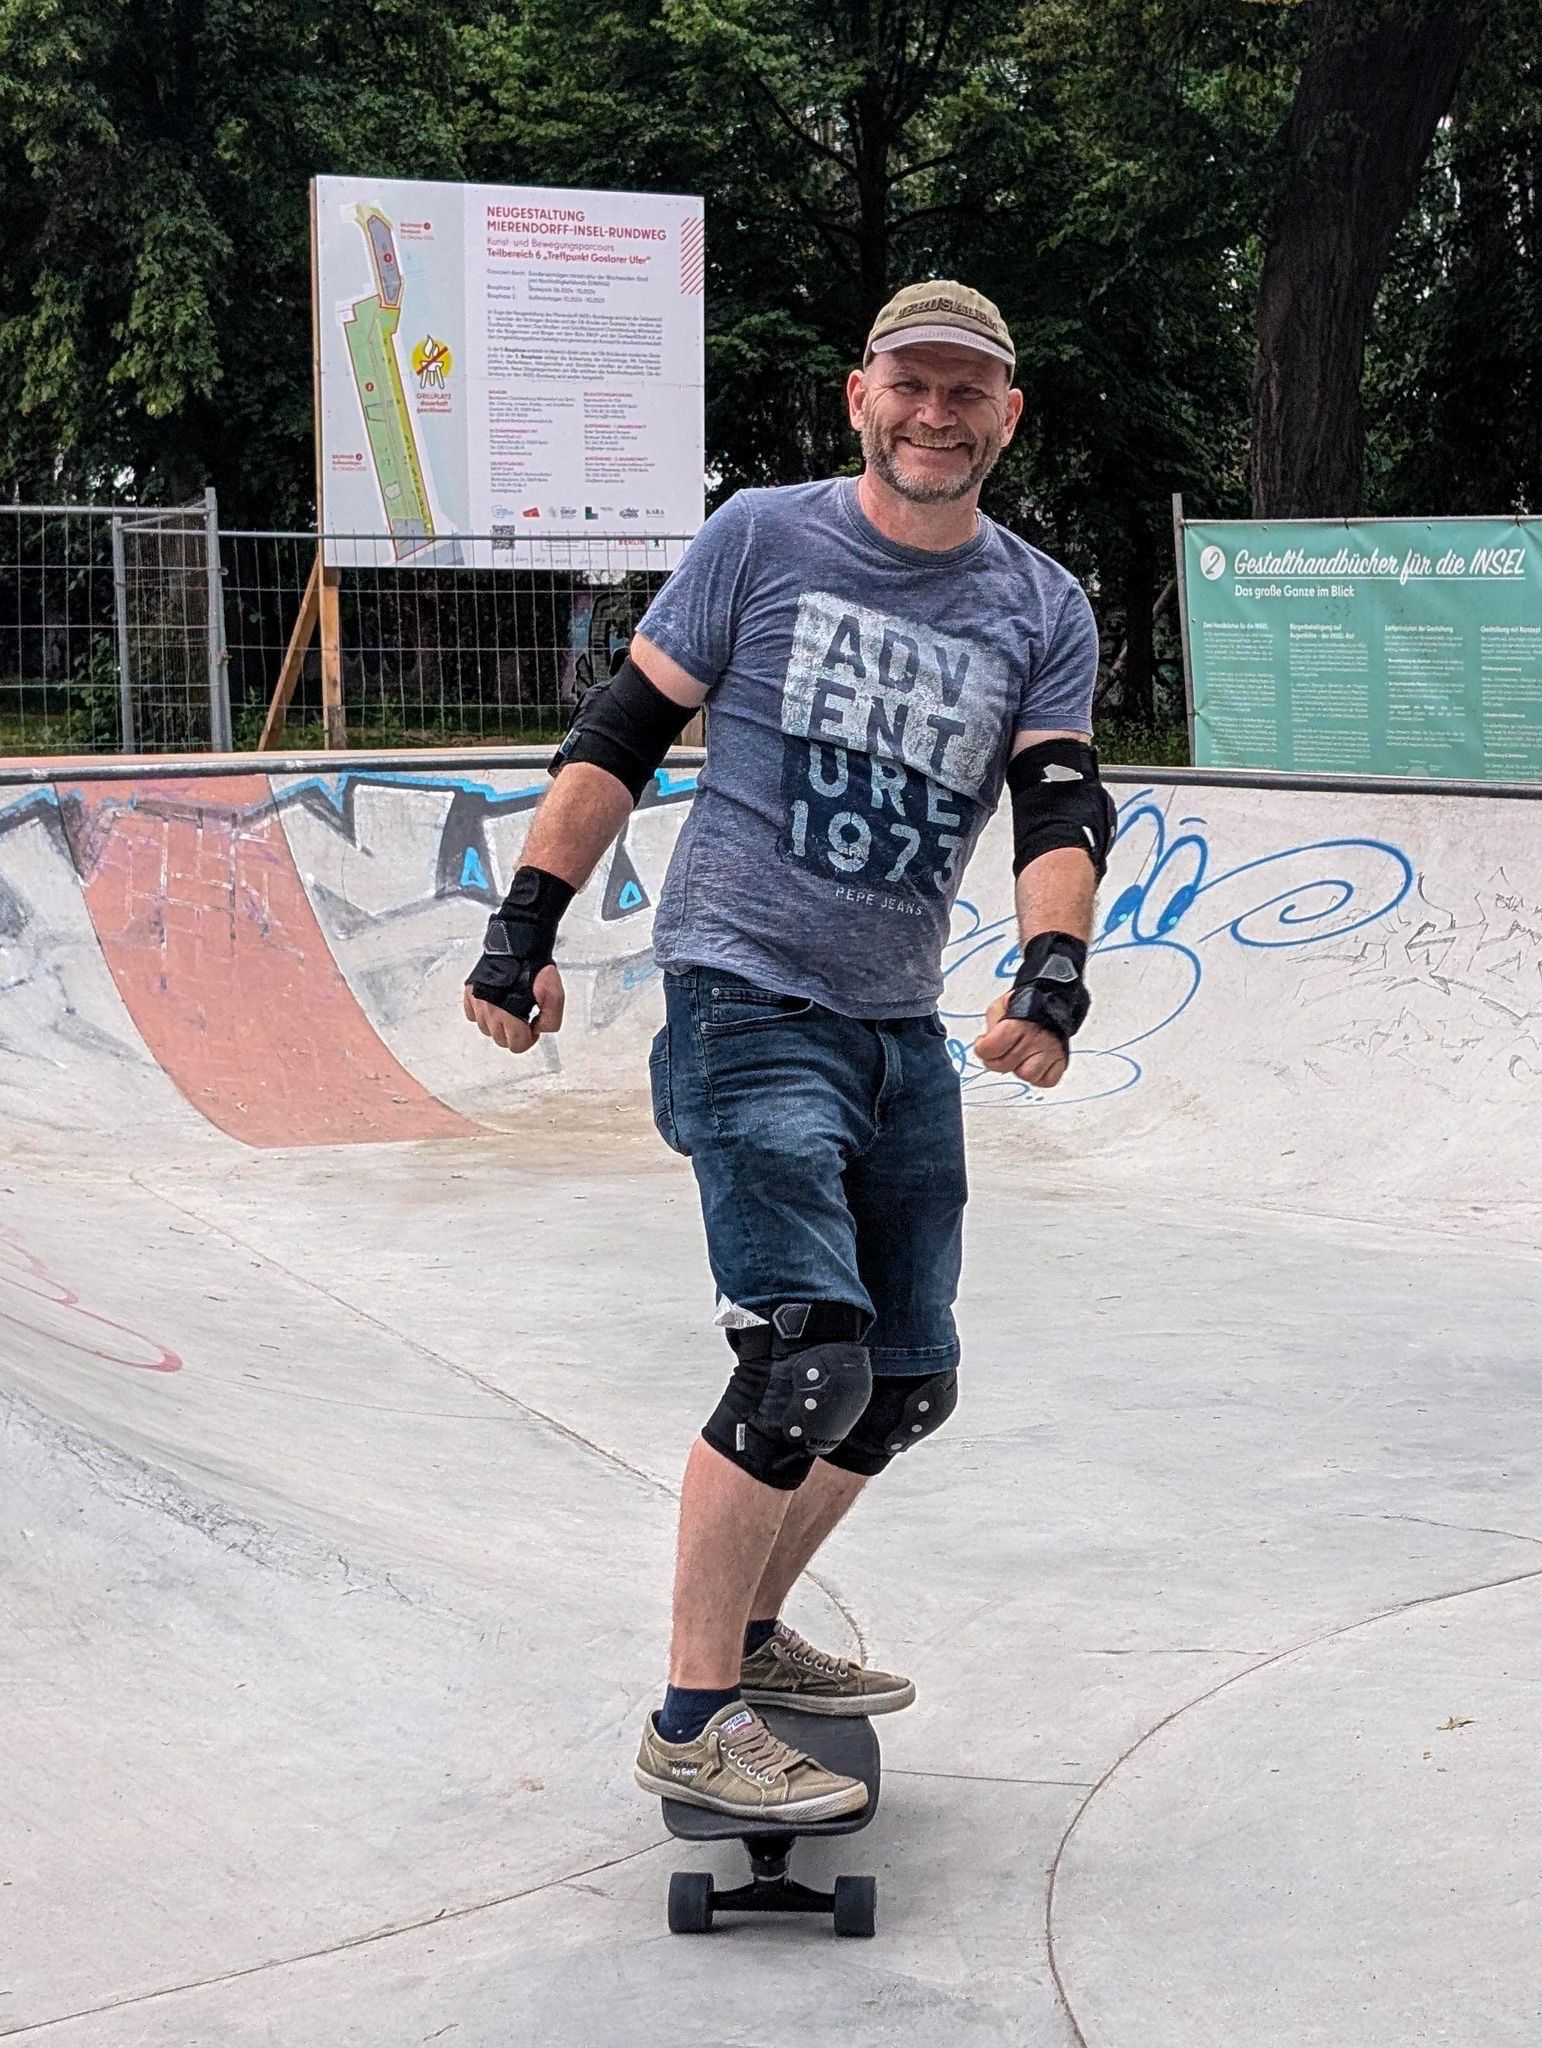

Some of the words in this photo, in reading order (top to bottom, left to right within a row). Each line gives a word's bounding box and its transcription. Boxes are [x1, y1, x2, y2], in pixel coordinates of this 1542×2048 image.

[487, 206, 585, 222] NEUGESTALTUNG
[487, 220, 667, 240] MIERENDORFF-INSEL-RUNDWEG
[487, 248, 534, 259] Teilbereich
[535, 251, 541, 259] 6
[590, 253, 627, 264] Goslarer
[513, 239, 529, 247] und
[531, 238, 615, 252] Bewegungsparcours
[1205, 551, 1220, 575] 2
[1234, 548, 1399, 575] Gestalthandbücher
[1400, 549, 1432, 586] für
[1436, 548, 1465, 575] die
[1469, 548, 1526, 575] INSEL
[1235, 585, 1253, 597] Das
[1255, 585, 1282, 599] große
[1284, 585, 1315, 597] Ganze
[1317, 585, 1329, 597] im
[1331, 585, 1355, 597] Blick
[822, 613, 971, 708] ADV
[808, 678, 967, 776] ENT
[808, 745, 961, 828] URE
[790, 799, 963, 894] 1973
[835, 887, 875, 906] PEPE
[881, 897, 922, 916] JEANS
[672, 1766, 680, 1777] by
